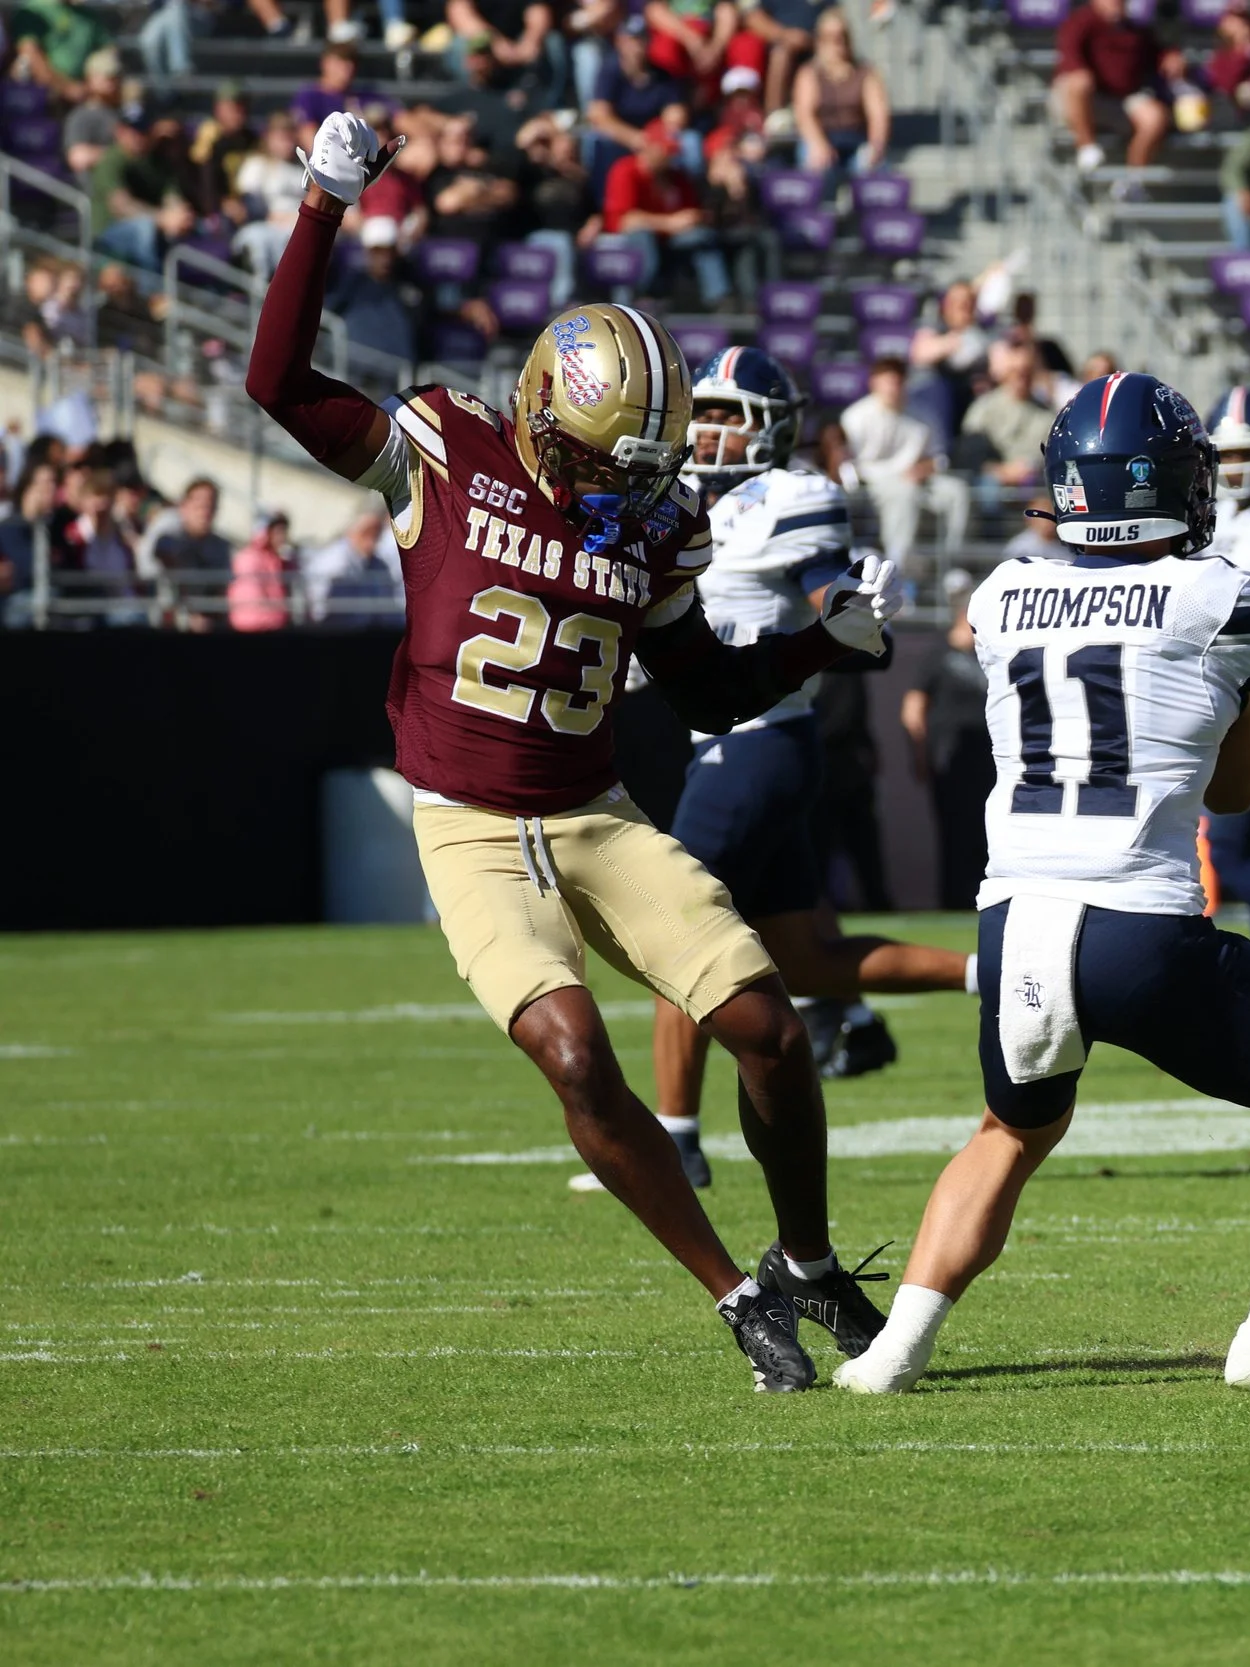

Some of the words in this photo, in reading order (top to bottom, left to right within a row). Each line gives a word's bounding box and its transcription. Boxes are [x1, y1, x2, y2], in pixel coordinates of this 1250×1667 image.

[468, 472, 528, 515] SBC
[465, 507, 563, 580] TEXAS
[573, 550, 651, 608] STATE
[1086, 524, 1140, 543] OWLS
[1000, 584, 1171, 633] THOMPSON
[451, 585, 623, 736] 23
[1007, 642, 1141, 818] 11
